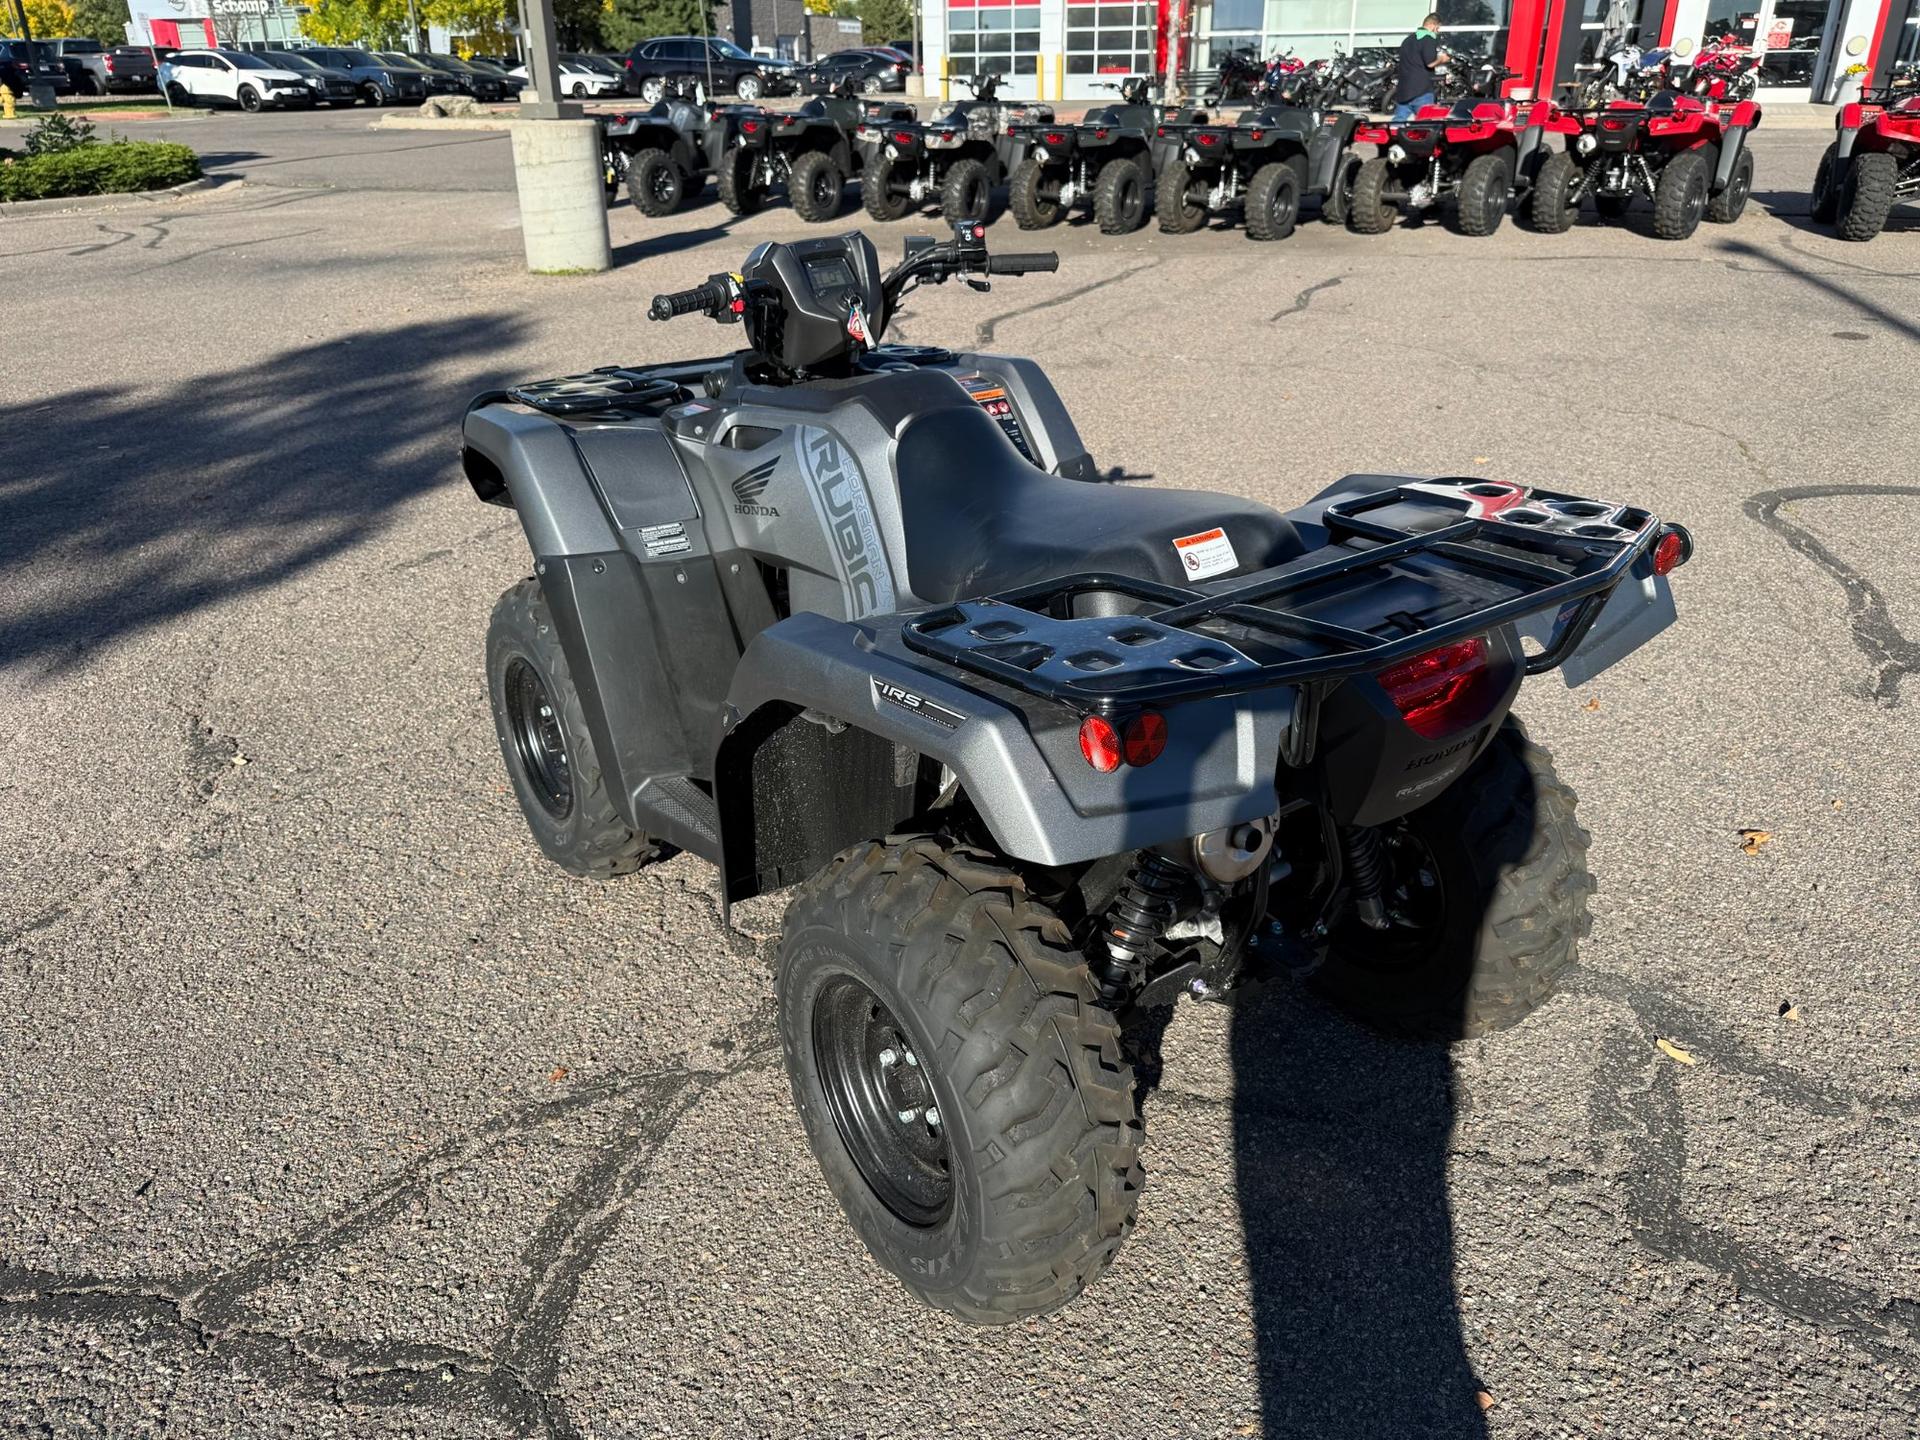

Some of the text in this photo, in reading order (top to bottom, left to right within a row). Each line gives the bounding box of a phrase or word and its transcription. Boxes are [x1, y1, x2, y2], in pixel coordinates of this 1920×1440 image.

[734, 504, 780, 517] HONDA
[810, 432, 877, 618] RUBIC
[843, 458, 884, 580] FOREMAN
[882, 685, 922, 708] IRS
